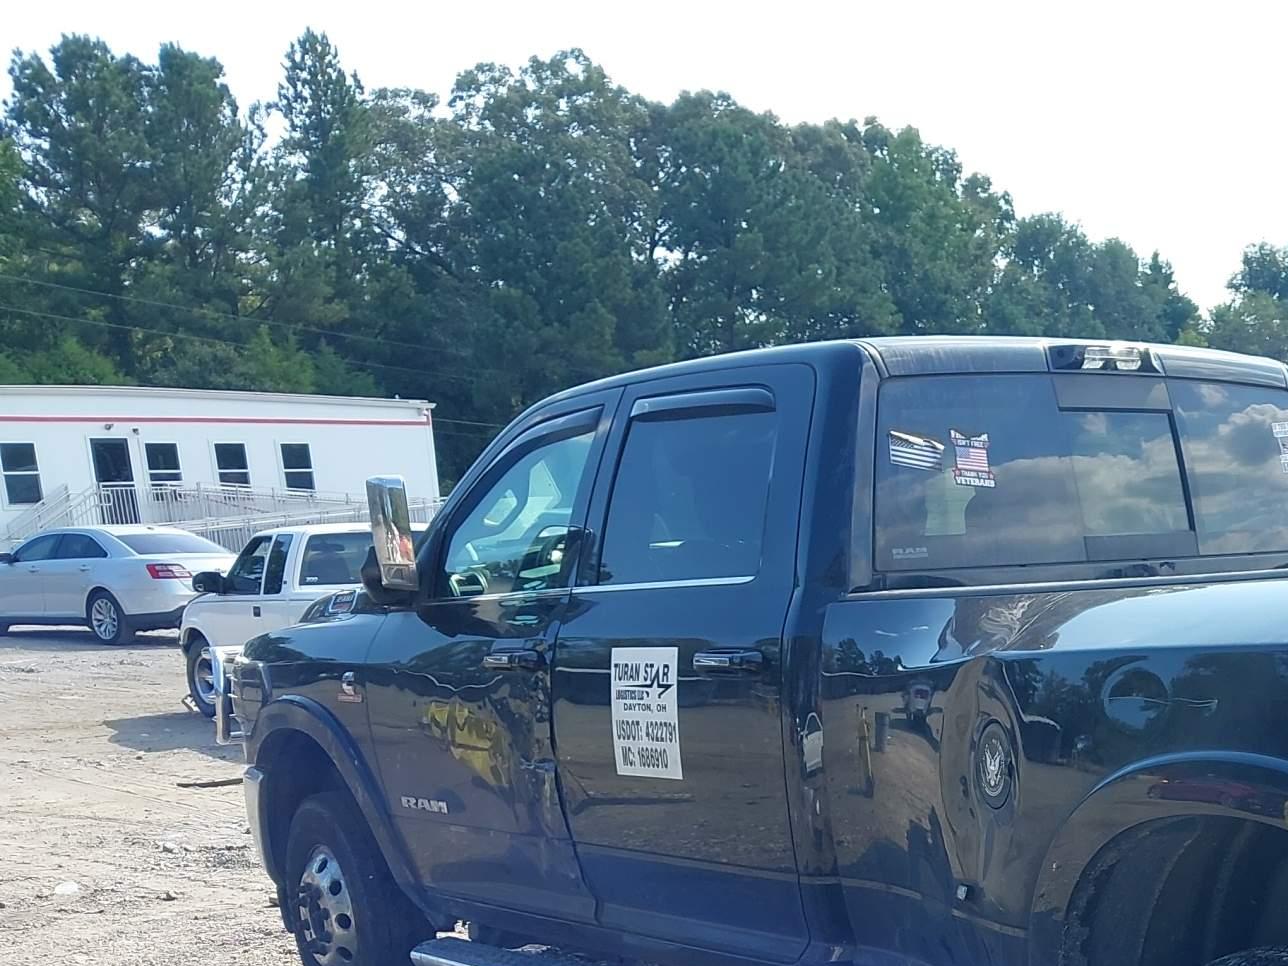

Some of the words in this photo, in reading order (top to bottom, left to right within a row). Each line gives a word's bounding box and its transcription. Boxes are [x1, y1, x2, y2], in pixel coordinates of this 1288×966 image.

[614, 663, 640, 681] TURAN
[643, 663, 670, 687] STAR
[624, 703, 653, 714] DAYTON,
[656, 704, 666, 713] OH
[616, 720, 643, 741] USDOT:
[645, 722, 677, 743] 4322791
[621, 746, 636, 767] MC:
[638, 748, 668, 769] 1686910
[401, 796, 448, 814] RAM
